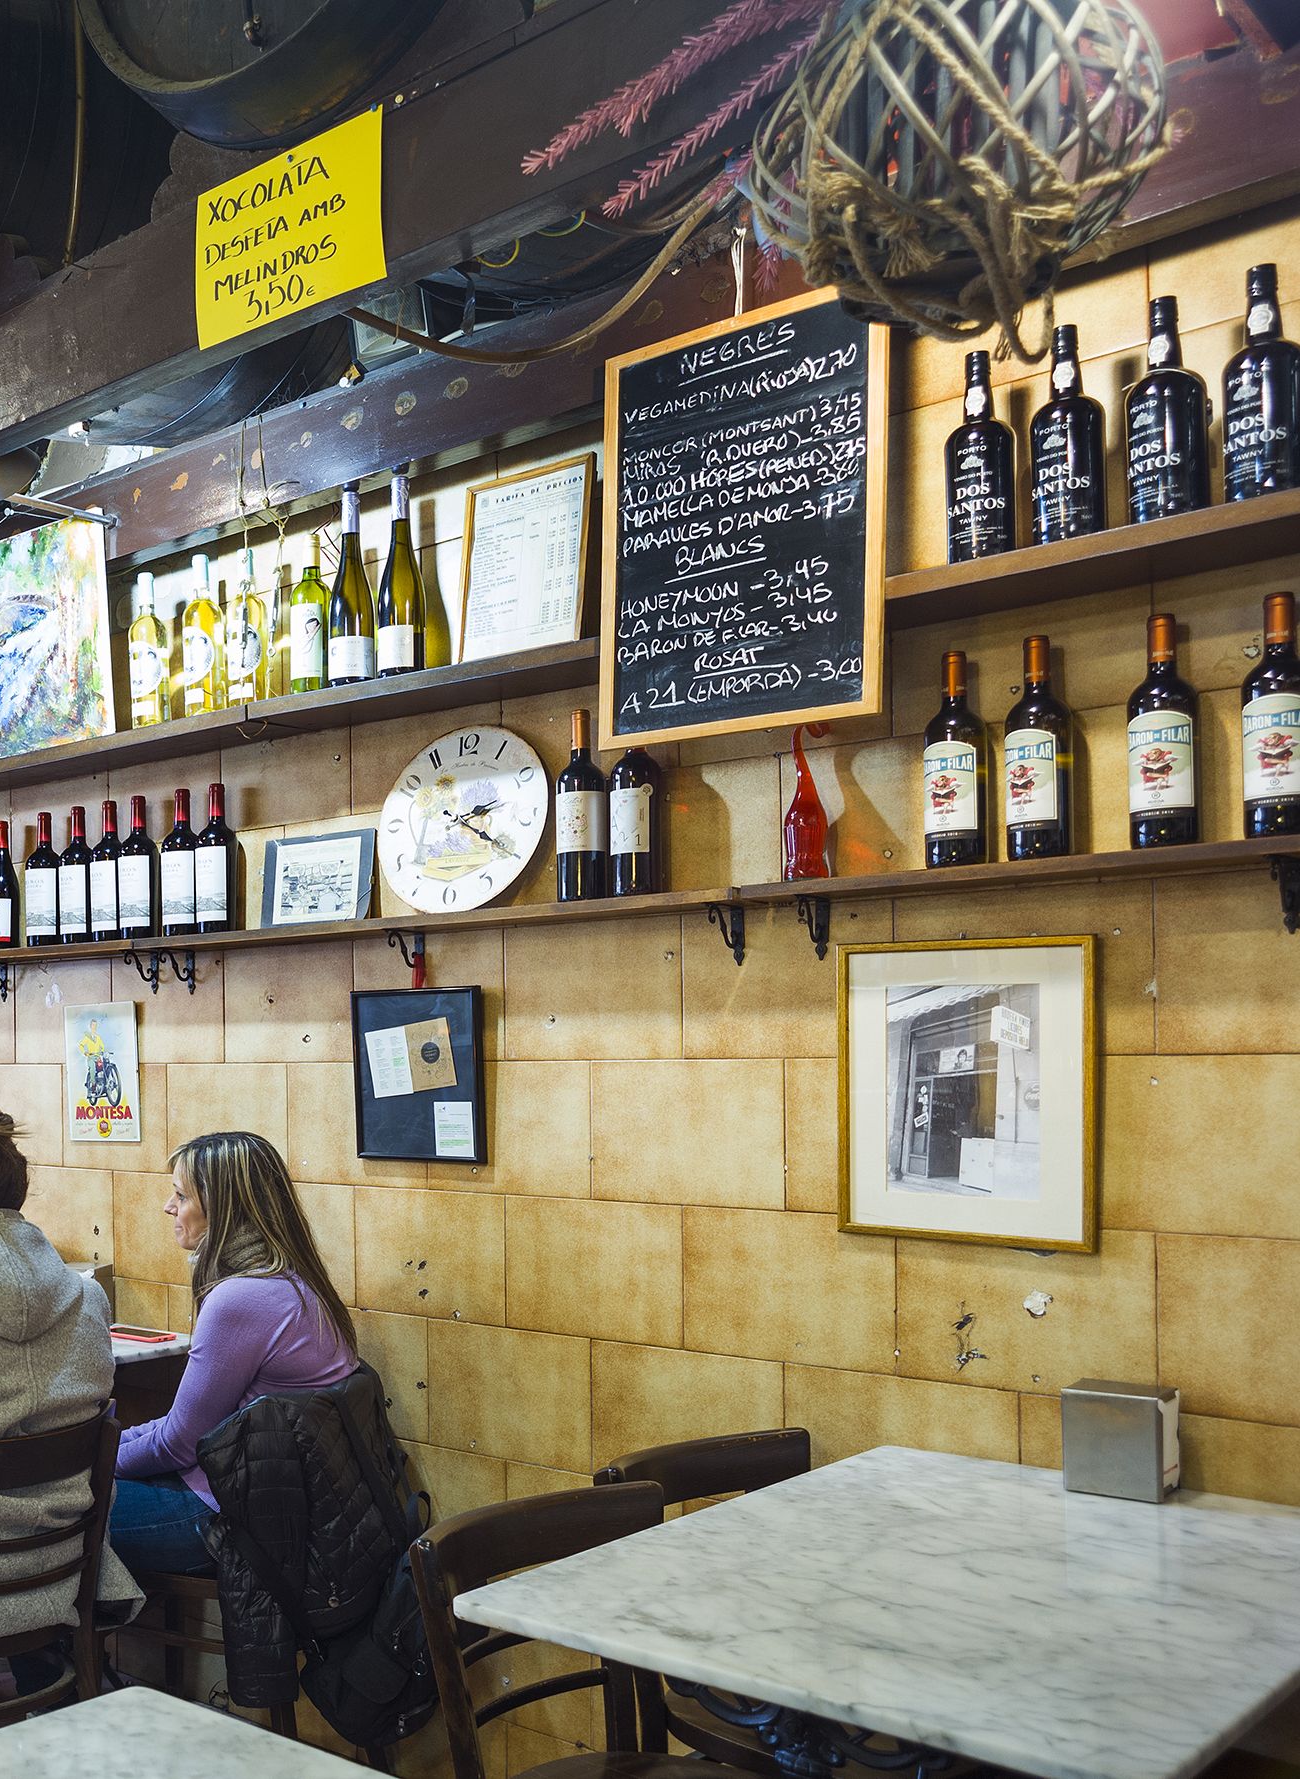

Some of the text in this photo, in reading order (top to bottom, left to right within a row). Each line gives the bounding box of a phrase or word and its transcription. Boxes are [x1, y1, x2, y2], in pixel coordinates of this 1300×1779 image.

[207, 156, 330, 226] XOCOLATA
[204, 193, 346, 271] DESFETA AMB
[214, 234, 337, 301] MELINDROS
[680, 322, 796, 375] NEGRES
[1228, 371, 1262, 388] POTO
[1039, 422, 1069, 436] PORTO
[1228, 413, 1265, 435] DOS
[957, 445, 987, 457] PORTO
[1130, 439, 1161, 462] DOS
[1222, 426, 1287, 456] SANTOS
[1127, 452, 1181, 480] ANTOS
[1232, 448, 1263, 463] TAWNY
[1038, 462, 1072, 482] DOS
[1132, 474, 1160, 488] TAWNY
[495, 491, 525, 504] TARIFA
[530, 486, 540, 495] DE
[546, 475, 583, 491] PRECIOS
[956, 481, 990, 500] DOS
[1031, 475, 1090, 502] SANTOS
[947, 496, 1006, 520] SANTOS
[1042, 494, 1071, 507] TAWNY
[959, 514, 988, 525] TAWNY
[622, 520, 713, 557] PARAULES
[675, 534, 767, 576] BLANCS
[620, 580, 739, 620] HONEYMOON
[617, 619, 651, 639] LA
[617, 633, 687, 667] BARON
[693, 631, 716, 648] DE
[693, 645, 765, 673] ROSAT
[1161, 725, 1190, 745] FILAR
[1243, 714, 1273, 736] BARON
[459, 734, 480, 757] 12
[1024, 741, 1053, 760] FILAR
[947, 754, 973, 771] FILAR
[75, 1104, 133, 1121] MONTESA
